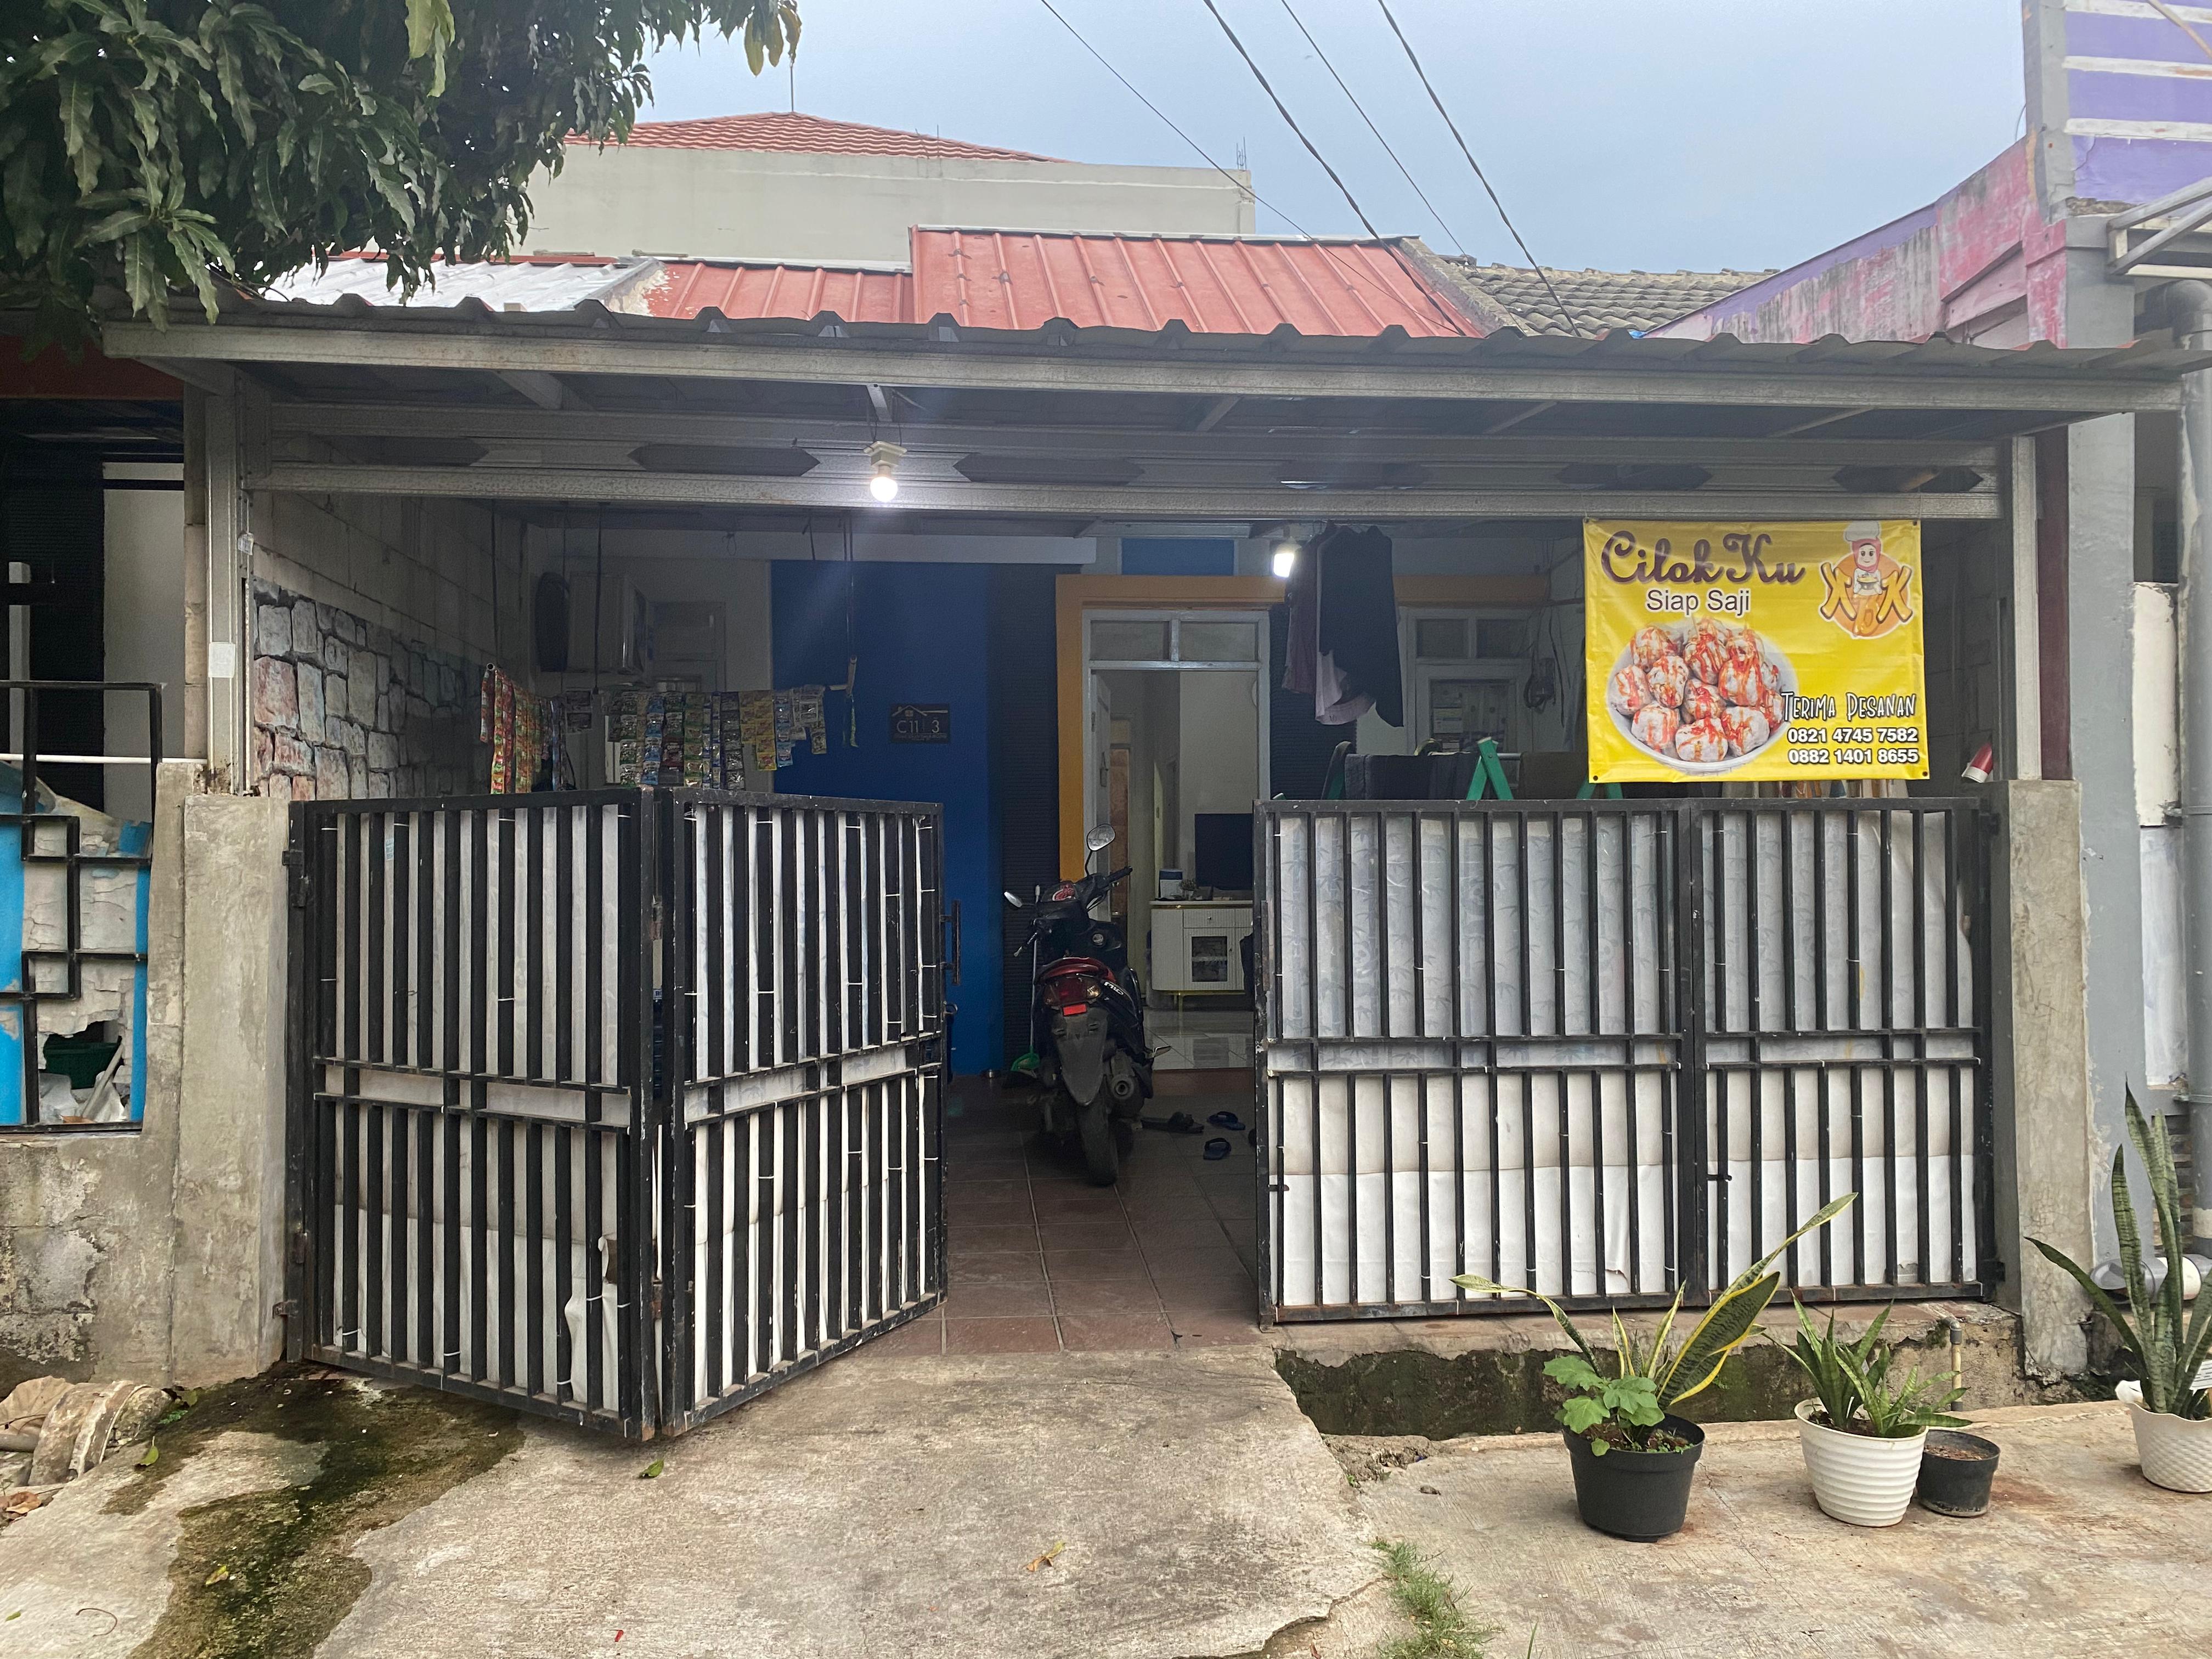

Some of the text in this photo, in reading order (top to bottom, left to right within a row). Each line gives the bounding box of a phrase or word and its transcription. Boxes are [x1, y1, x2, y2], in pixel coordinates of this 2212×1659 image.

[1601, 530, 1806, 583] Cilok Ku
[1646, 589, 1750, 616] Siap Saji
[1846, 692, 1916, 721] PESANAN
[932, 719, 939, 733] 3
[1787, 727, 1918, 743] 0821 4745 7582
[1788, 747, 1919, 764] 0882 1401 8655
